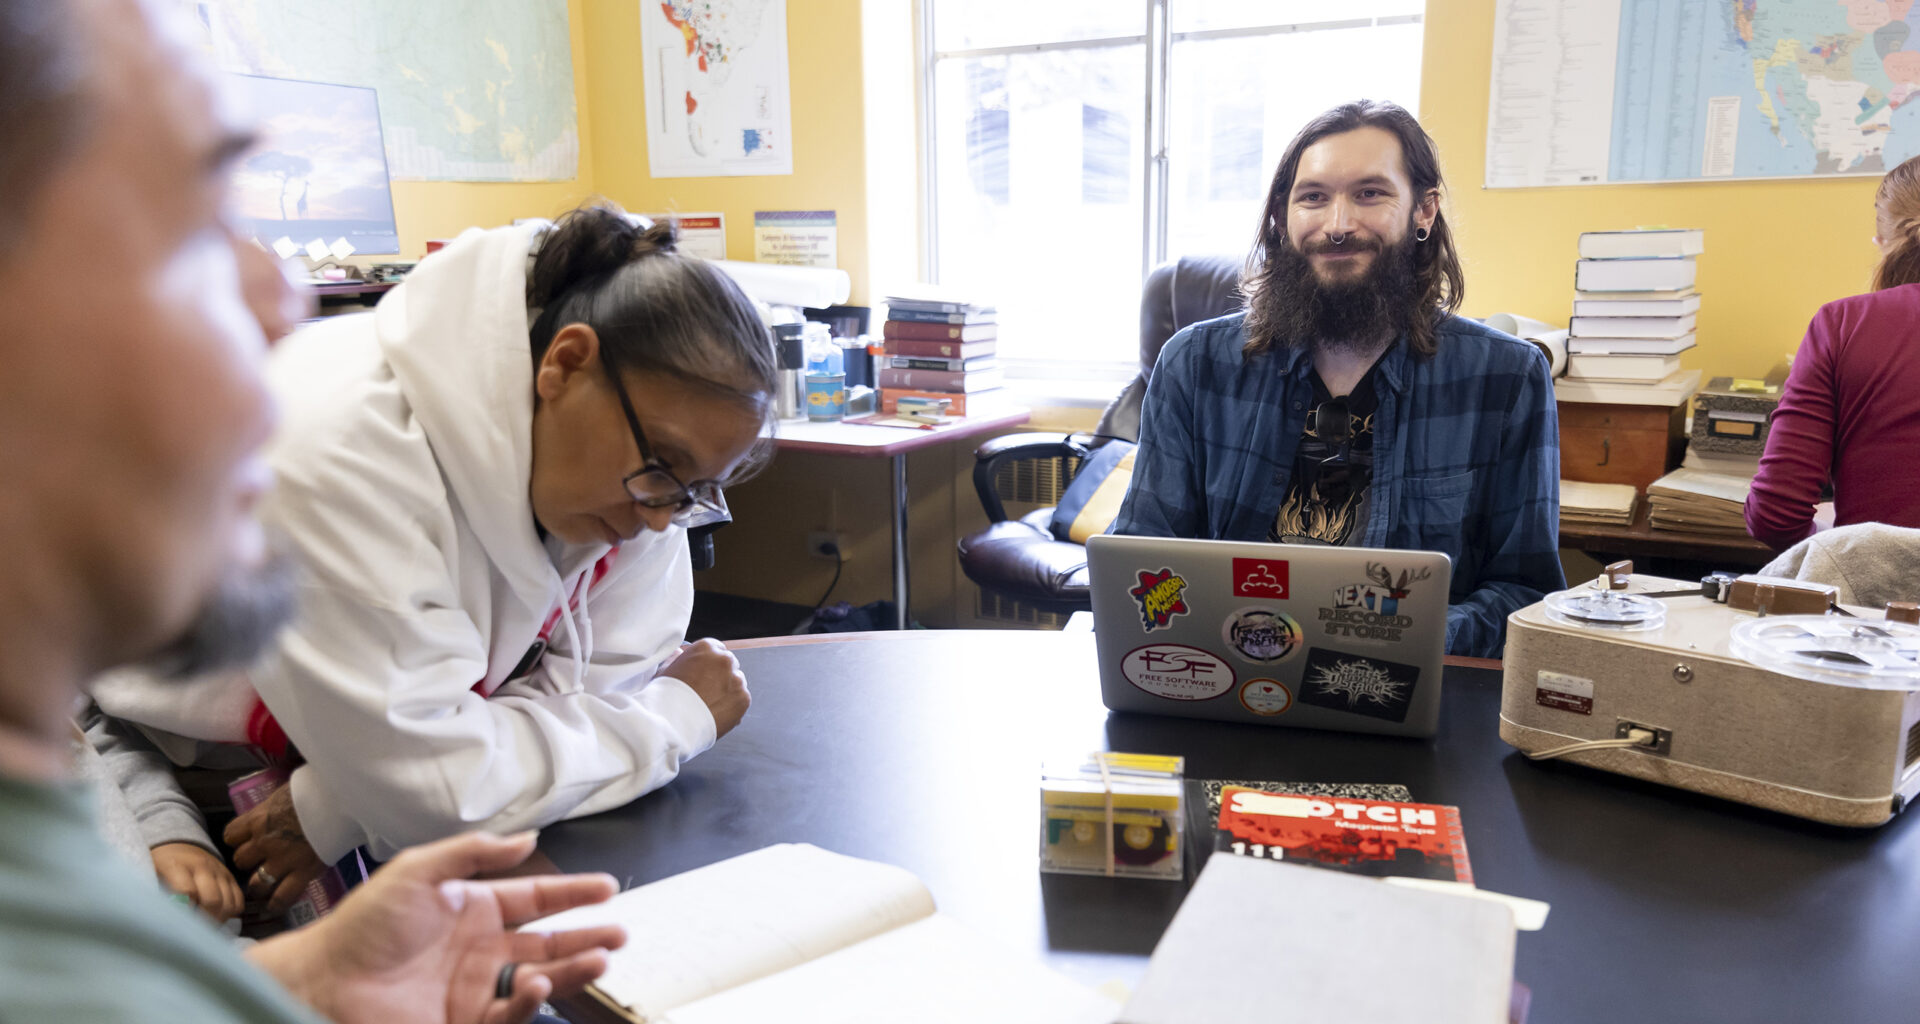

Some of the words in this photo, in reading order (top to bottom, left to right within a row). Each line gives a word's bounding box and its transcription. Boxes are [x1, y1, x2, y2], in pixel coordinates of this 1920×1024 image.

[1332, 584, 1391, 615] NEXT
[1318, 607, 1413, 629] RECORD
[1324, 622, 1402, 642] STORE
[1139, 650, 1216, 679] FSF
[1139, 673, 1163, 682] FREE
[1165, 676, 1217, 688] SOFTWARE
[1230, 792, 1437, 826] SOTCH
[1334, 820, 1400, 833] Magnetic
[1404, 823, 1437, 836] Tape
[1231, 841, 1284, 861] 111
